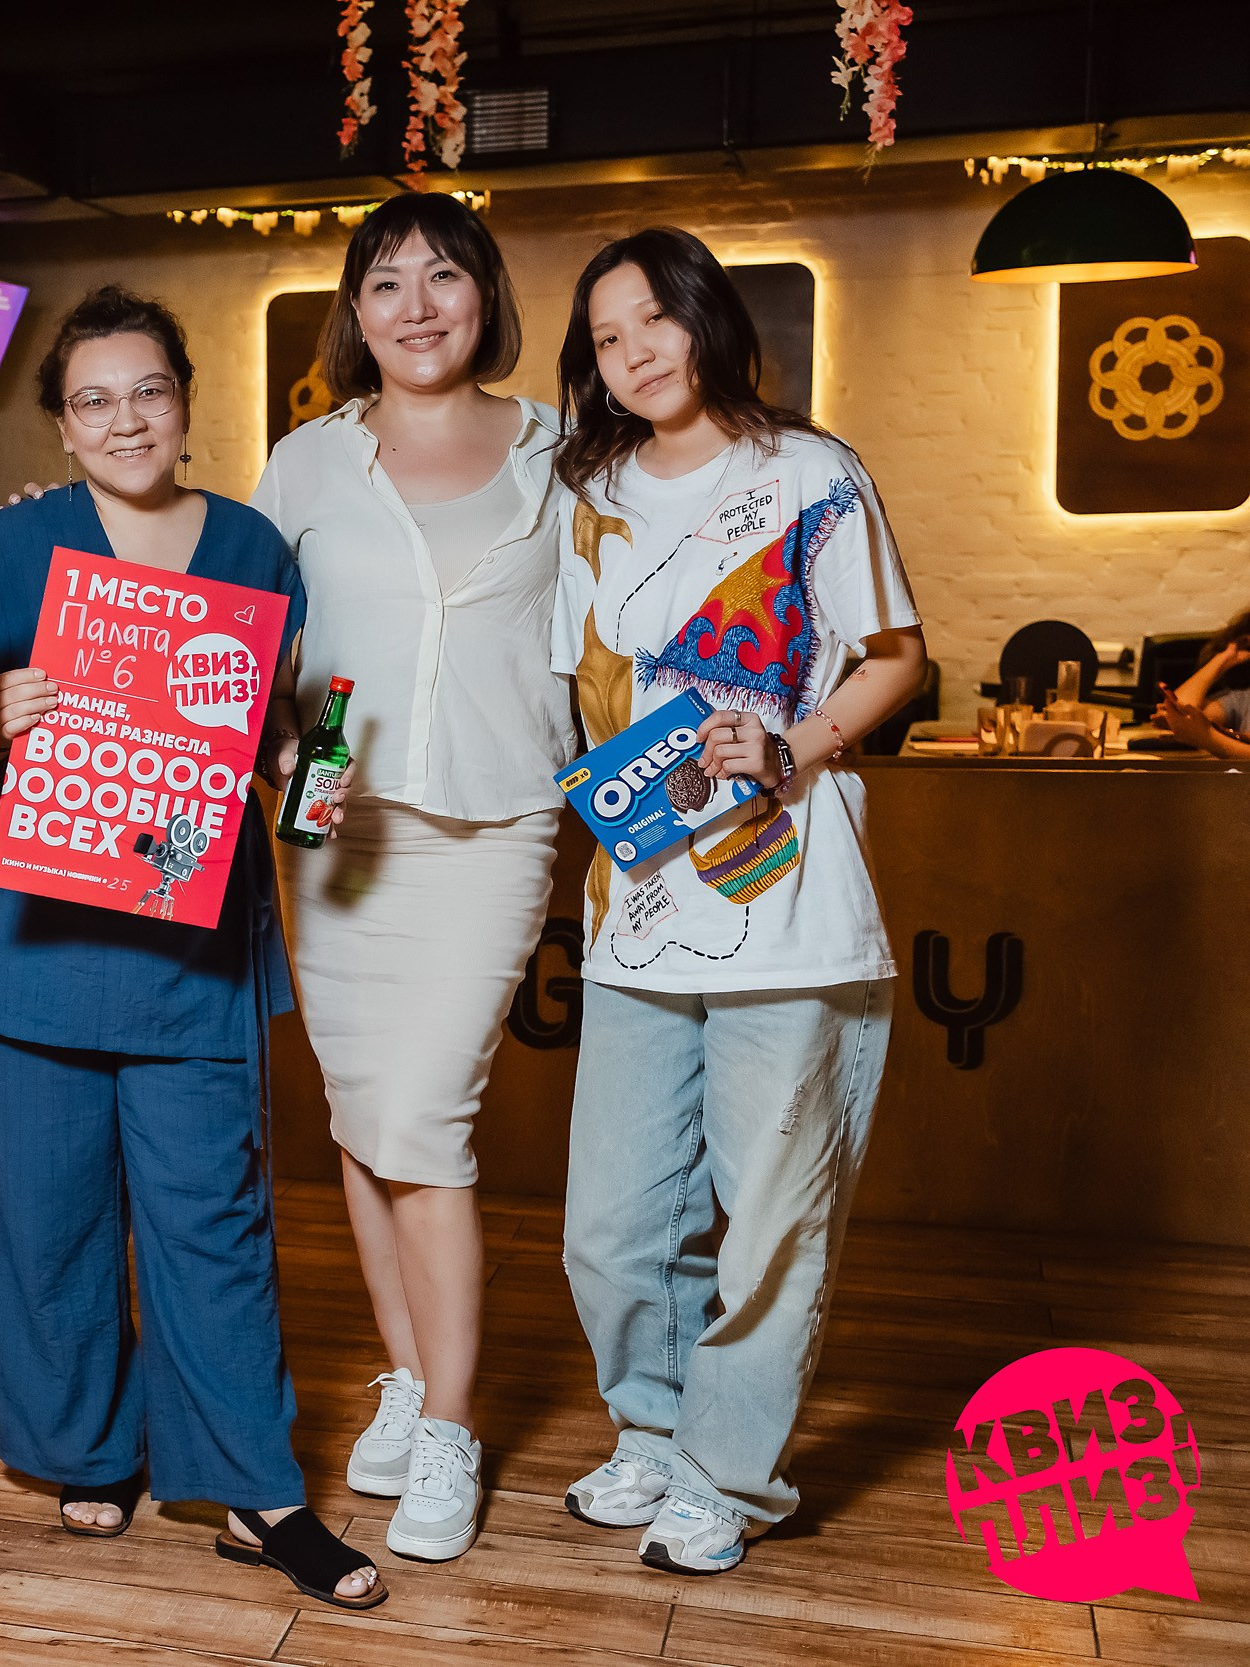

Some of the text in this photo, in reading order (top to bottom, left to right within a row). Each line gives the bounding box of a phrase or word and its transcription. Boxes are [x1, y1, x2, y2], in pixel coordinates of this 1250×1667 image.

[719, 495, 773, 523] PROTECTED
[746, 490, 756, 501] I
[726, 517, 766, 541] PEOPLE
[743, 509, 759, 523] MY
[66, 568, 208, 623] 1 МЕСТО
[56, 600, 171, 658] Палата
[57, 690, 131, 722] МАНДЕ,
[170, 679, 258, 707] ПЛИЗ!
[41, 711, 211, 757] ОТОРАЯ РАЗНЕСЛА
[593, 727, 698, 818] OREO
[7, 803, 126, 859] ВСЕХ
[628, 809, 667, 834] ORIGINAL
[26, 862, 32, 870] И
[107, 877, 132, 891] 25
[625, 874, 661, 909] I WAS TAKEN
[628, 883, 664, 921] AWAY FROM
[632, 895, 670, 933] MY PEOPLE
